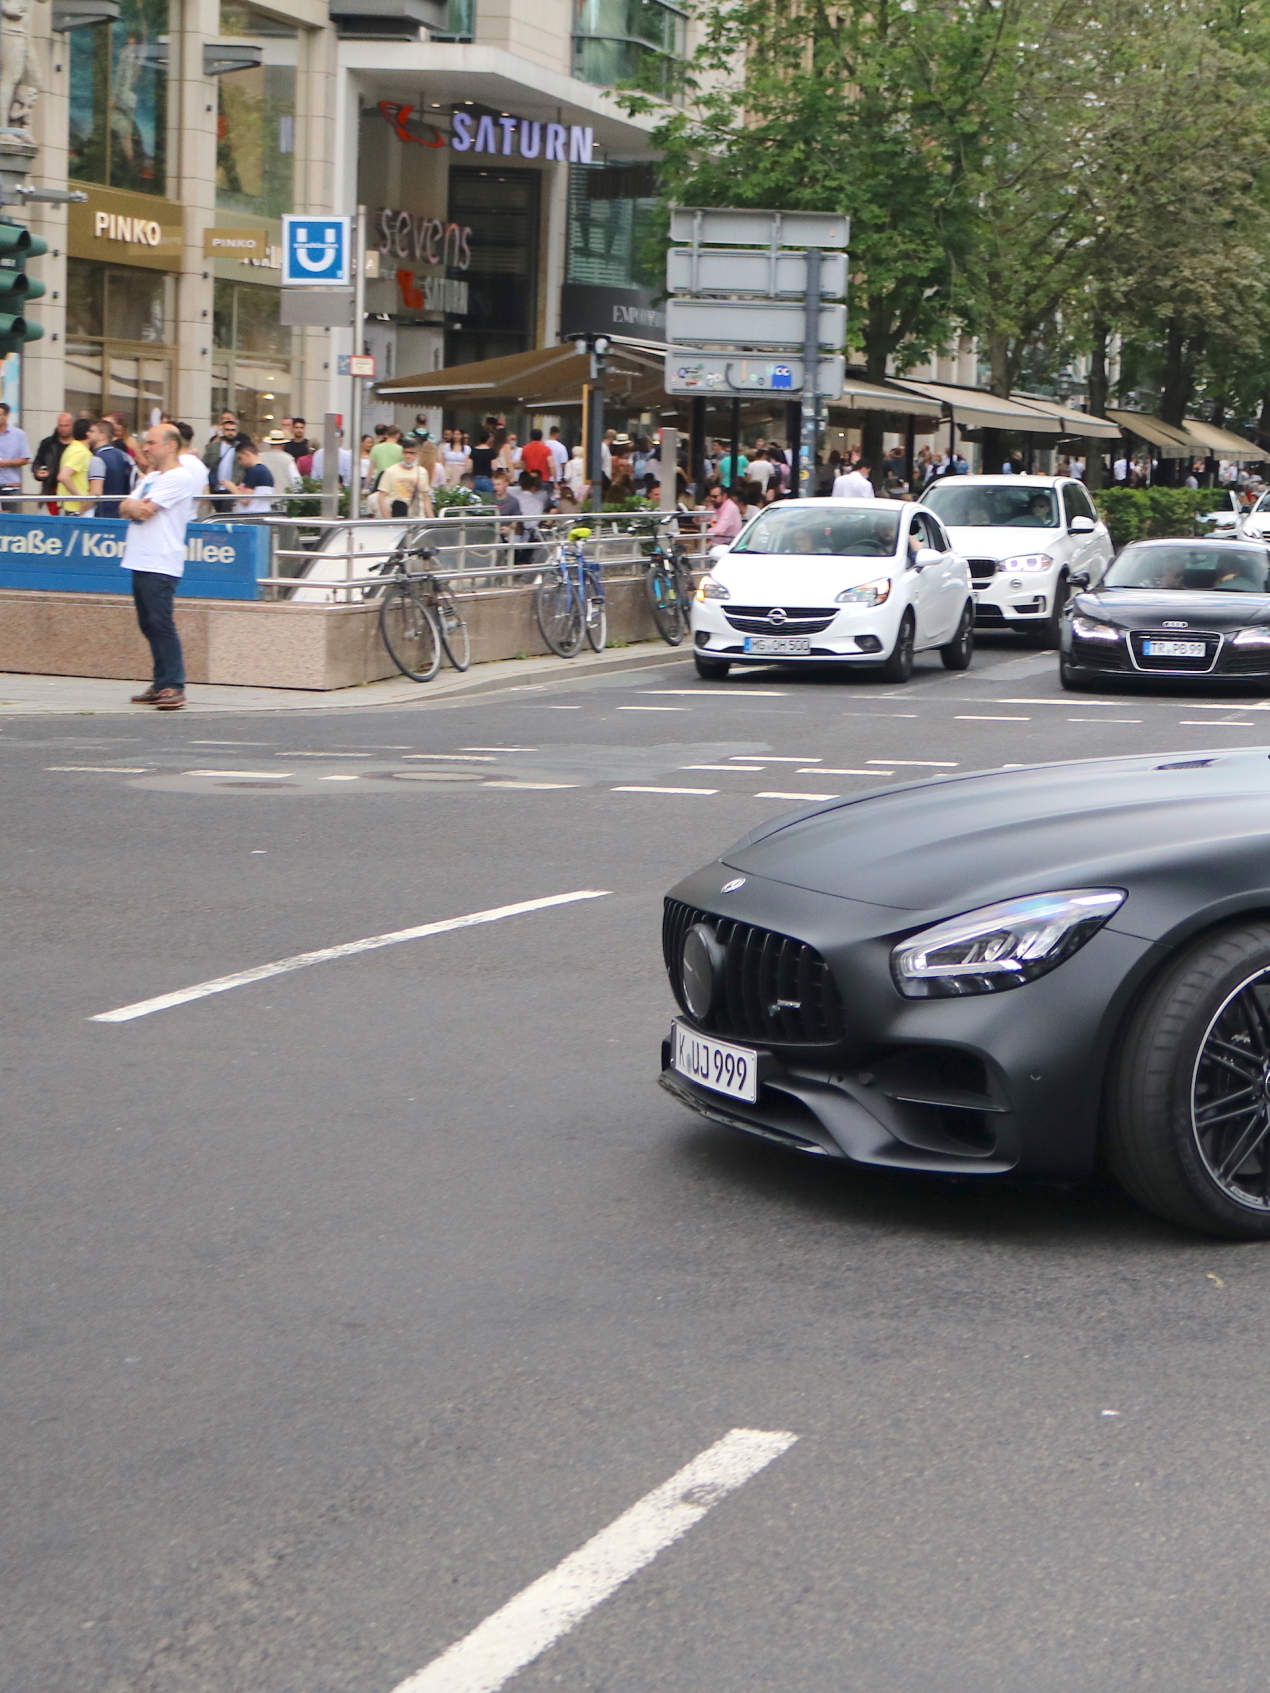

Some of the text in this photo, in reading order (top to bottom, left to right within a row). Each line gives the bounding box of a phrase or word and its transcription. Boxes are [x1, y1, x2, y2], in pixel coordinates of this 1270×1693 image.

[452, 113, 593, 163] SATURN
[95, 212, 161, 246] PINKO
[212, 238, 257, 248] PINKO
[380, 208, 472, 270] sevens
[0, 530, 62, 555] raße
[713, 1049, 748, 1092] 999
